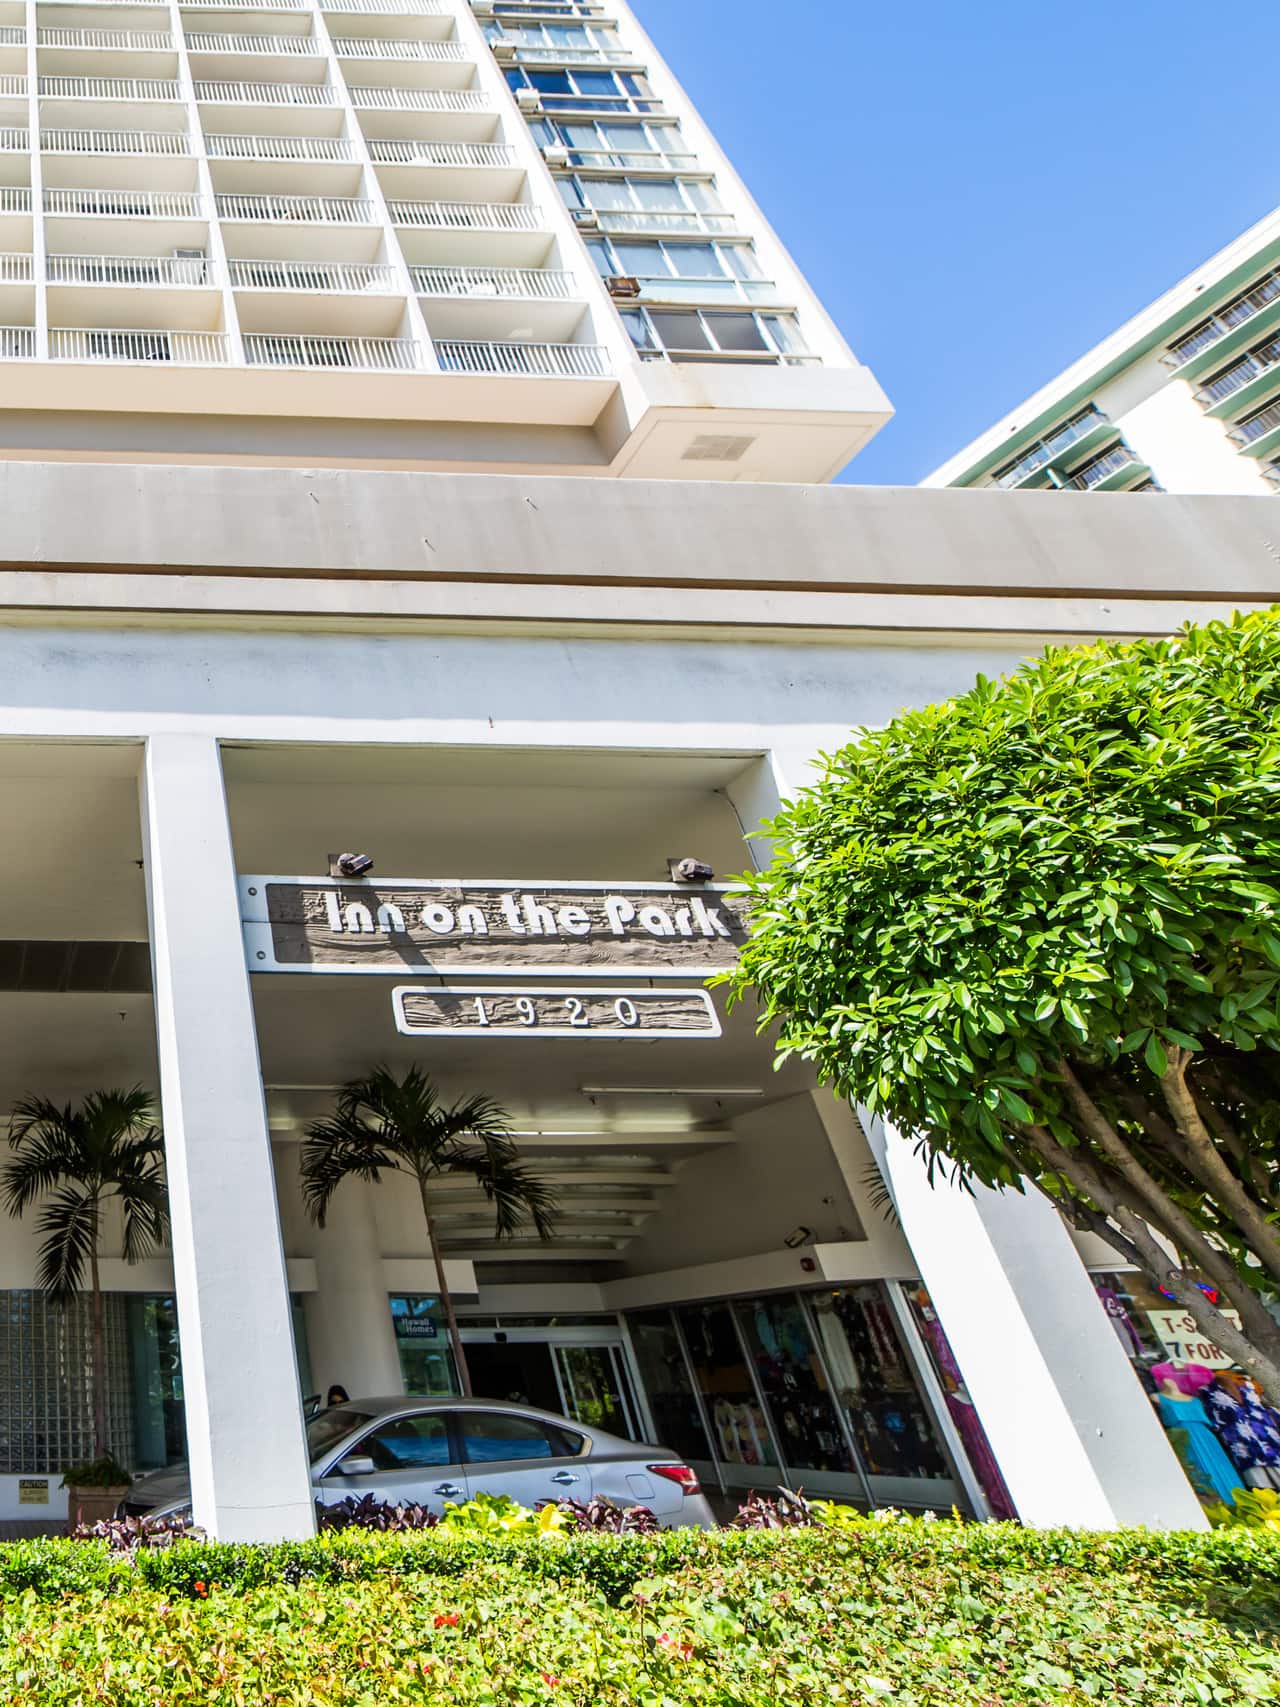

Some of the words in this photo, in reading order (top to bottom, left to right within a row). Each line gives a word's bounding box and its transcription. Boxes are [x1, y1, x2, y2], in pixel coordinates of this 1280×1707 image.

[325, 891, 406, 934] Inn
[421, 903, 489, 935] on
[501, 894, 592, 935] the
[604, 895, 732, 937] Park
[473, 997, 638, 1026] 1920
[1161, 1316, 1237, 1334] T-ST
[1166, 1342, 1181, 1358] 7
[1184, 1342, 1225, 1360] FOR
